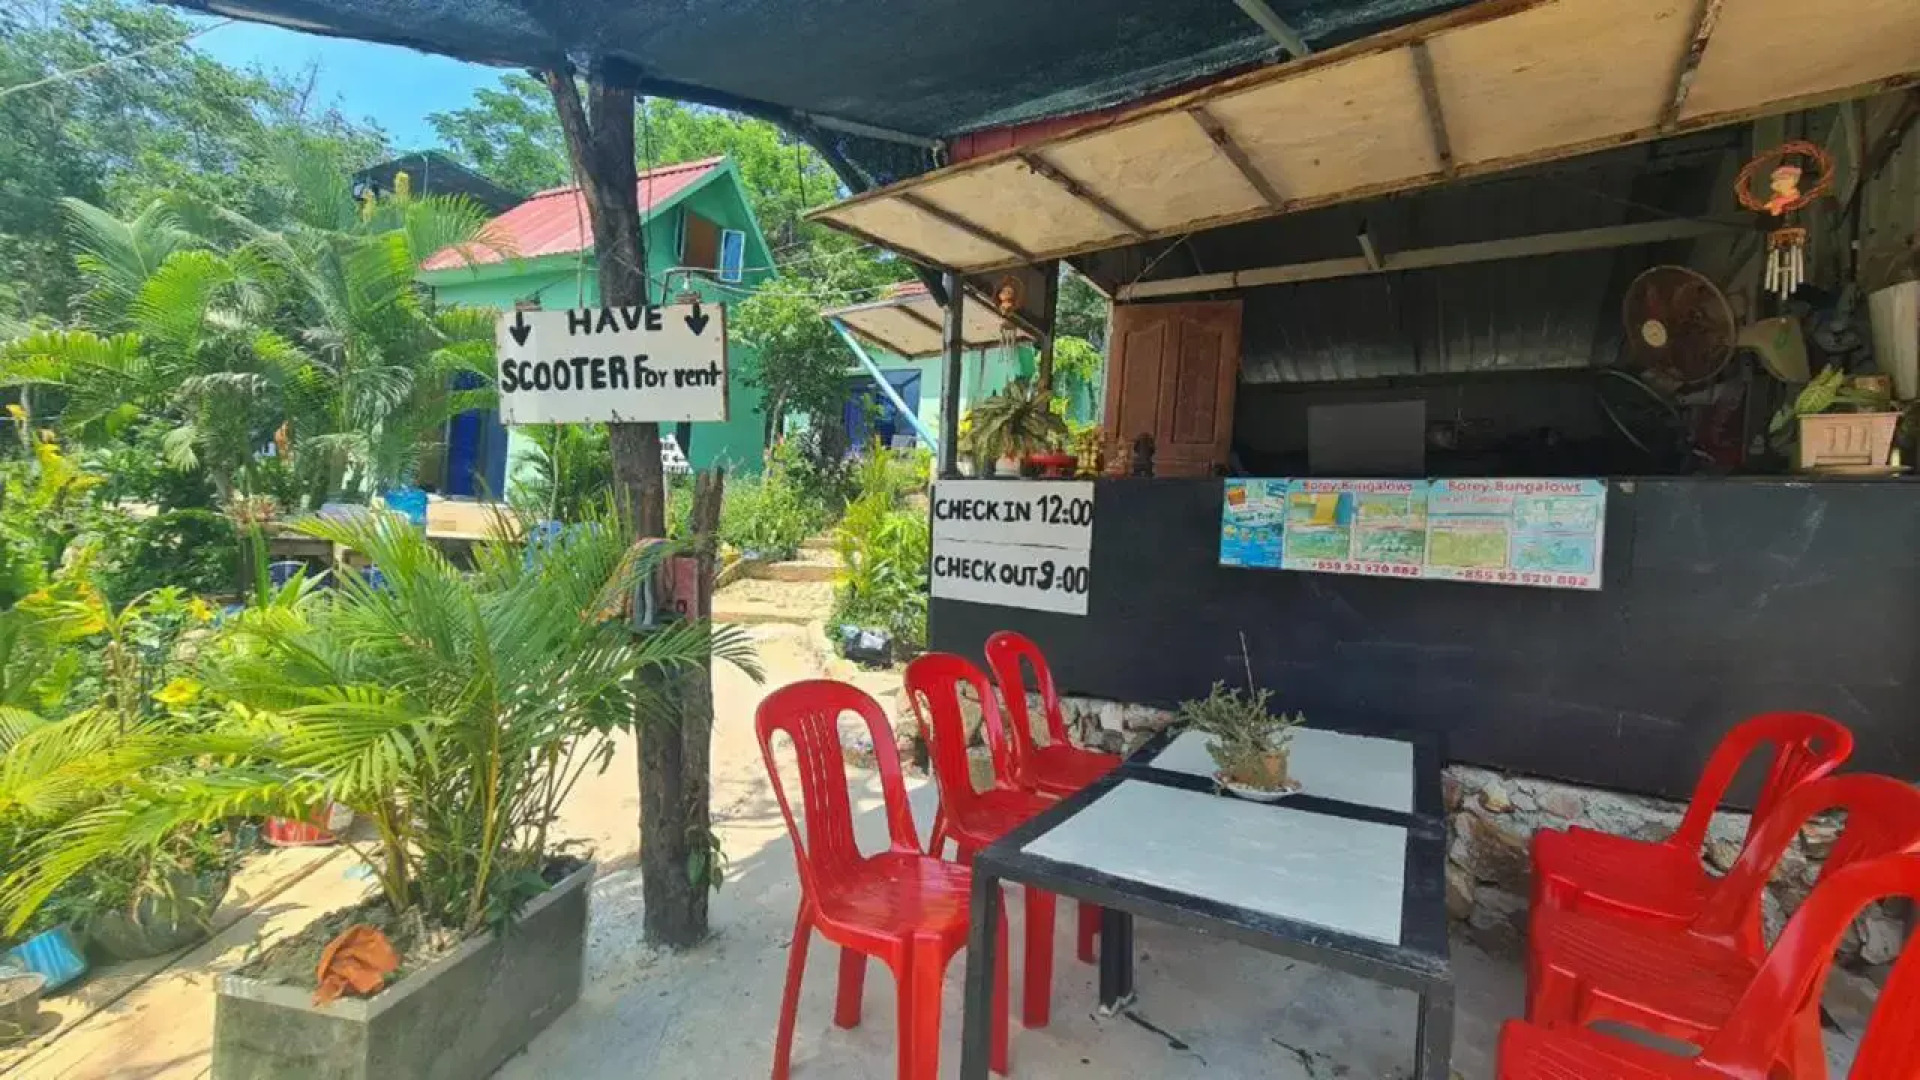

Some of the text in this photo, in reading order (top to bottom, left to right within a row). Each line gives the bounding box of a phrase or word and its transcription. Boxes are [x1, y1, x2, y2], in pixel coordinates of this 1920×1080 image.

[567, 304, 663, 336] HAVE
[501, 354, 722, 393] SCOOTER For rent
[1494, 481, 1582, 495] Bungalows
[935, 494, 1093, 527] CHECK IN 12:00
[934, 554, 1090, 595] CHECK OUT 9:00
